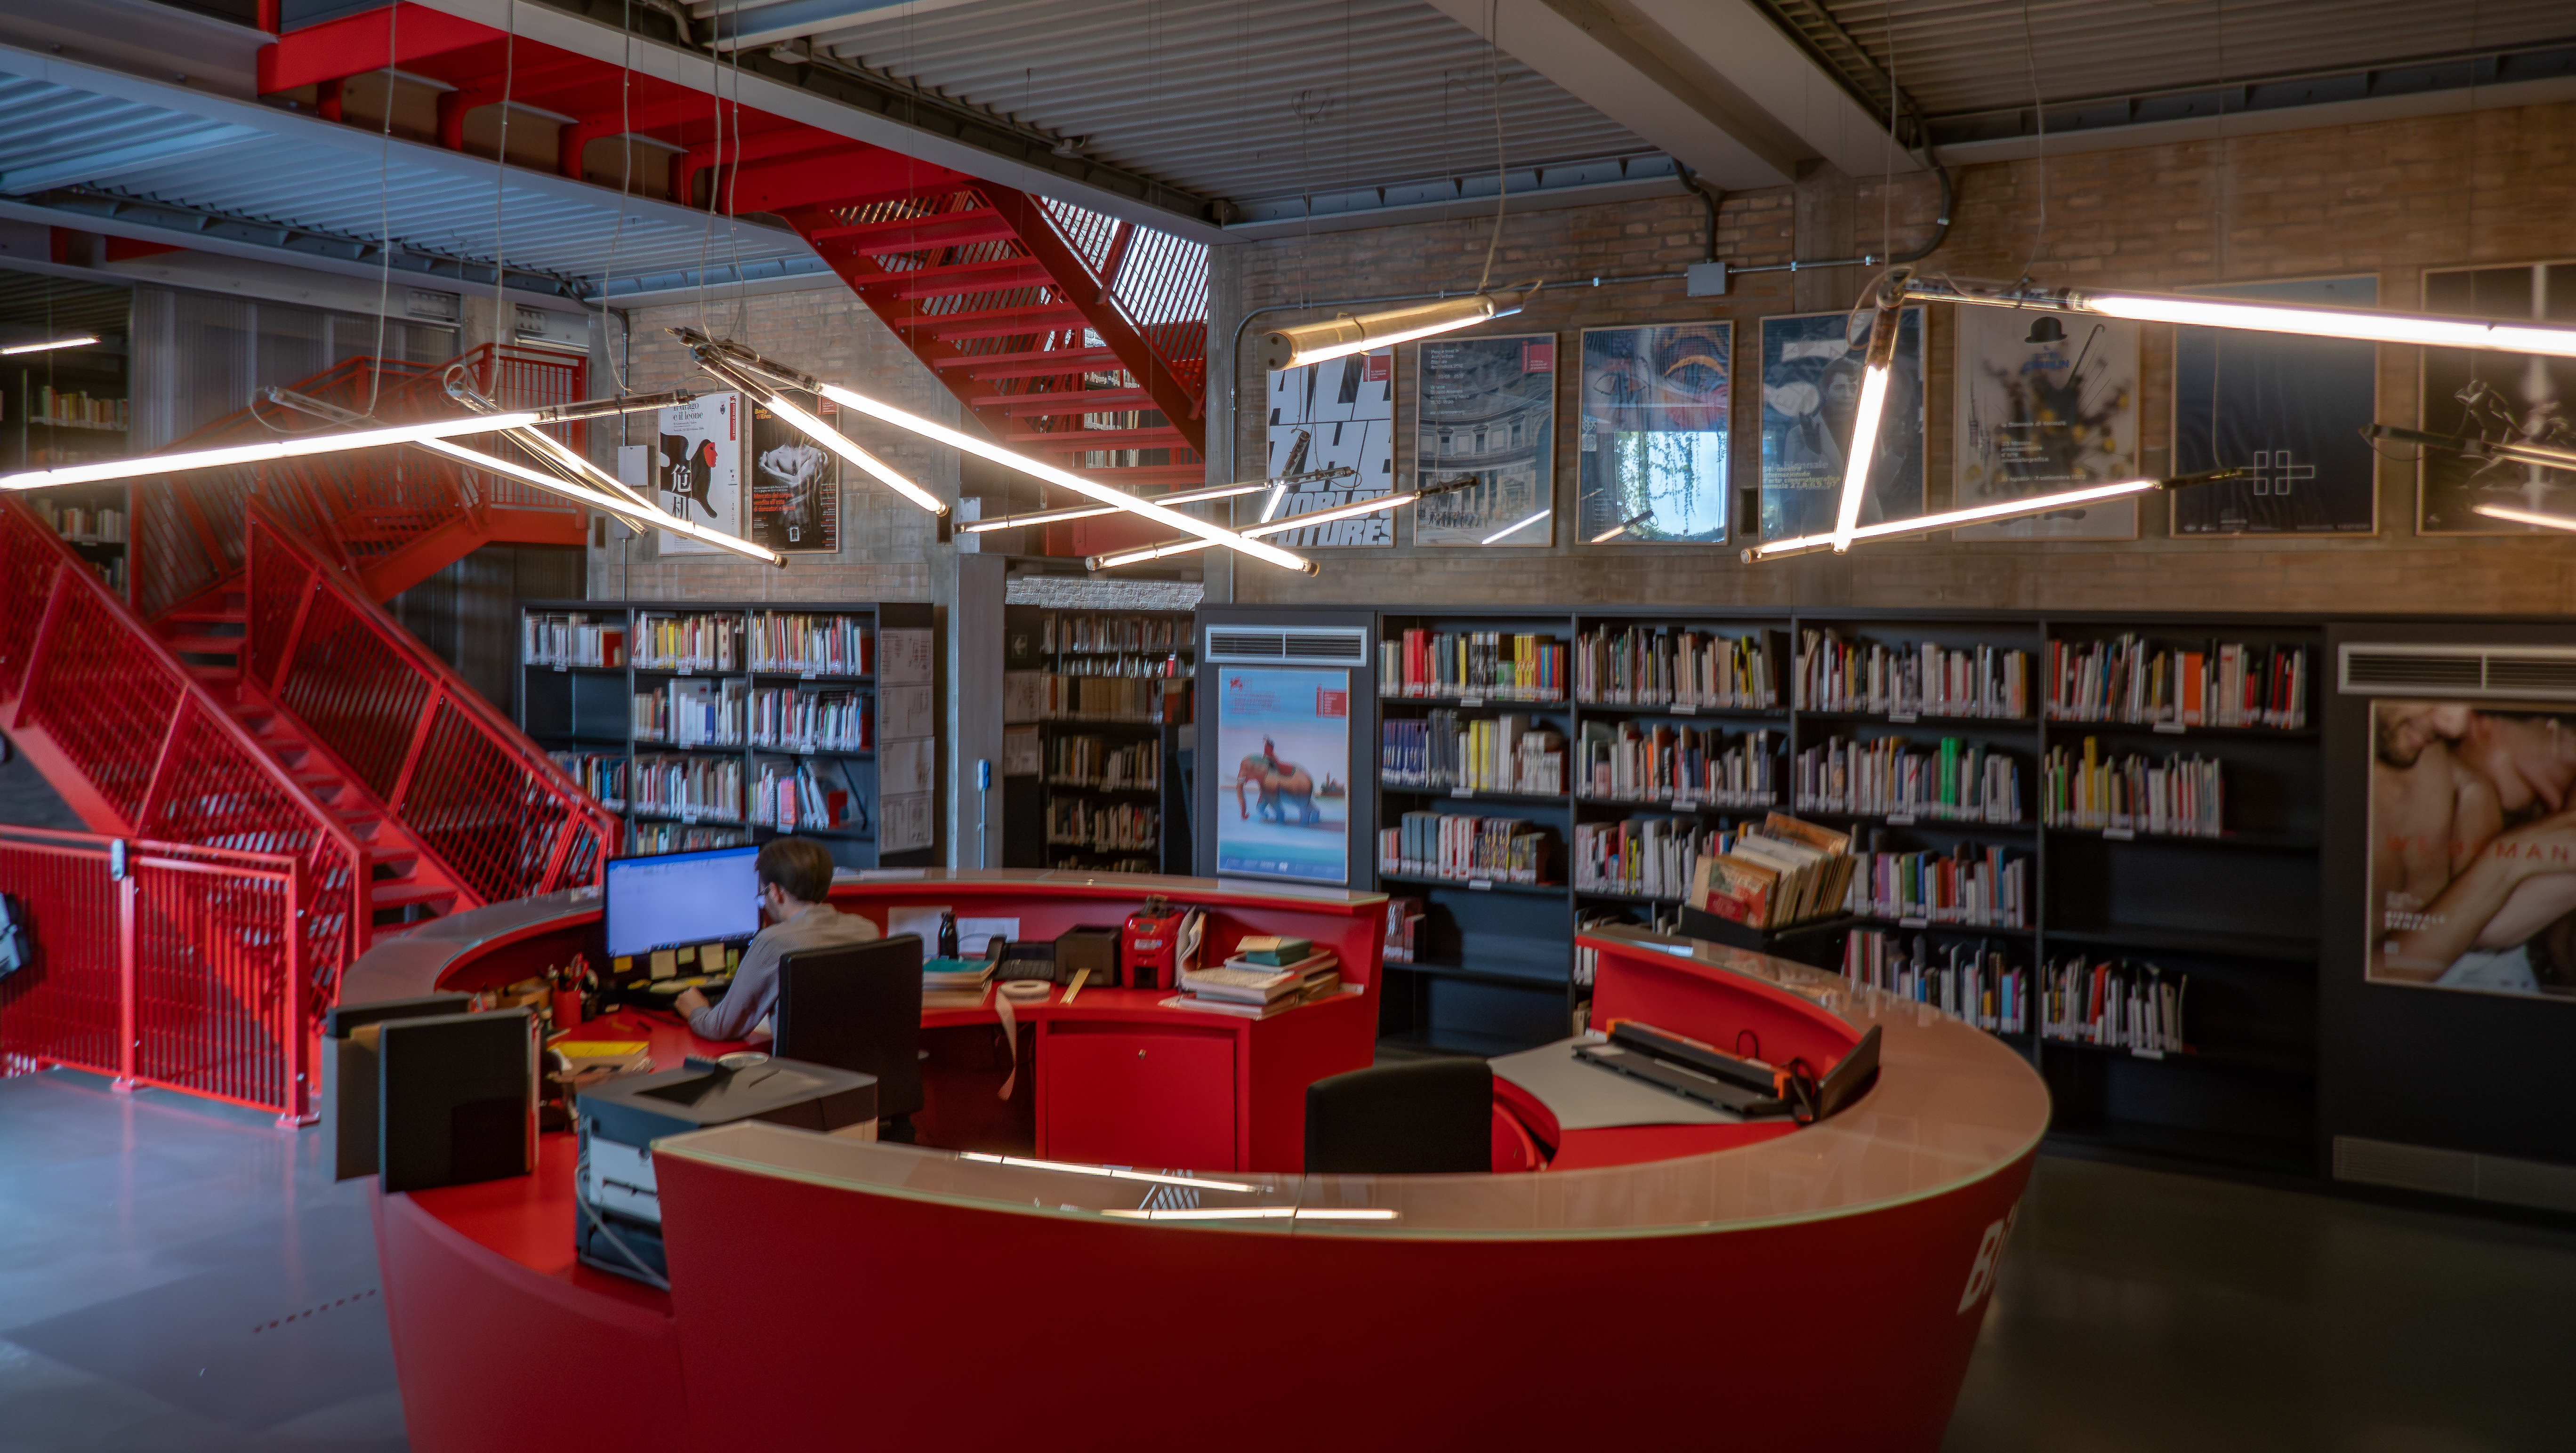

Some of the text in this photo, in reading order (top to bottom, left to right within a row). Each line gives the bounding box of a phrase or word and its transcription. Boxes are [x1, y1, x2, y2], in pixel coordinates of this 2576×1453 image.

[679, 412, 683, 420] il
[684, 411, 703, 419] leone
[1270, 419, 1391, 493] THE
